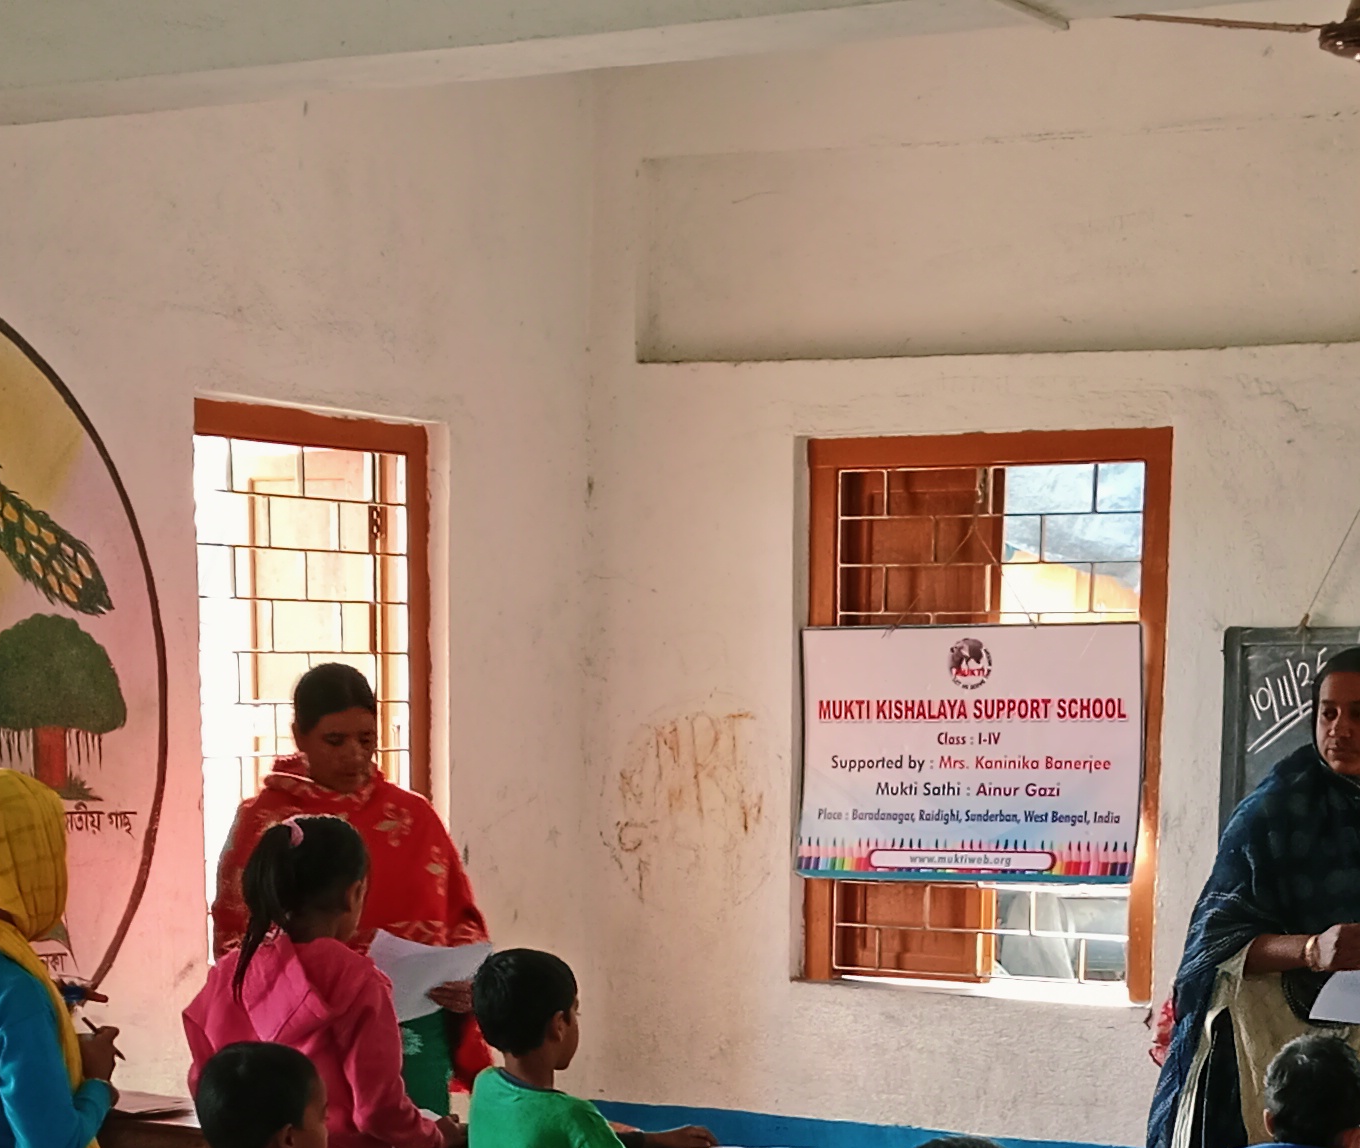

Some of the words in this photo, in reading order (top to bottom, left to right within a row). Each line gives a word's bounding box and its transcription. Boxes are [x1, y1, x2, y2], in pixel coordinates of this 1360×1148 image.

[818, 700, 871, 721] MUKTI
[876, 699, 968, 721] KISHALAYA
[973, 698, 1052, 720] SUPPORT
[1056, 698, 1127, 720] SCHOOL
[937, 732, 966, 745] Class
[978, 732, 1001, 745] I-IV
[831, 755, 903, 772] Supported
[908, 755, 925, 773] by
[939, 756, 969, 770] Mrs.
[975, 755, 1039, 770] Kaninika
[1045, 755, 1111, 774] Banerjee
[875, 781, 918, 796] Mukti
[923, 781, 961, 796] Sathi
[976, 782, 1020, 797] Ainur
[1025, 782, 1060, 797] Gazi
[817, 808, 843, 820] Place
[918, 809, 962, 825] Raidighi,
[1024, 810, 1049, 823] West
[1051, 810, 1090, 827] Bengal,
[1093, 811, 1121, 824] India
[909, 854, 1012, 867] www.muktiweb.org
